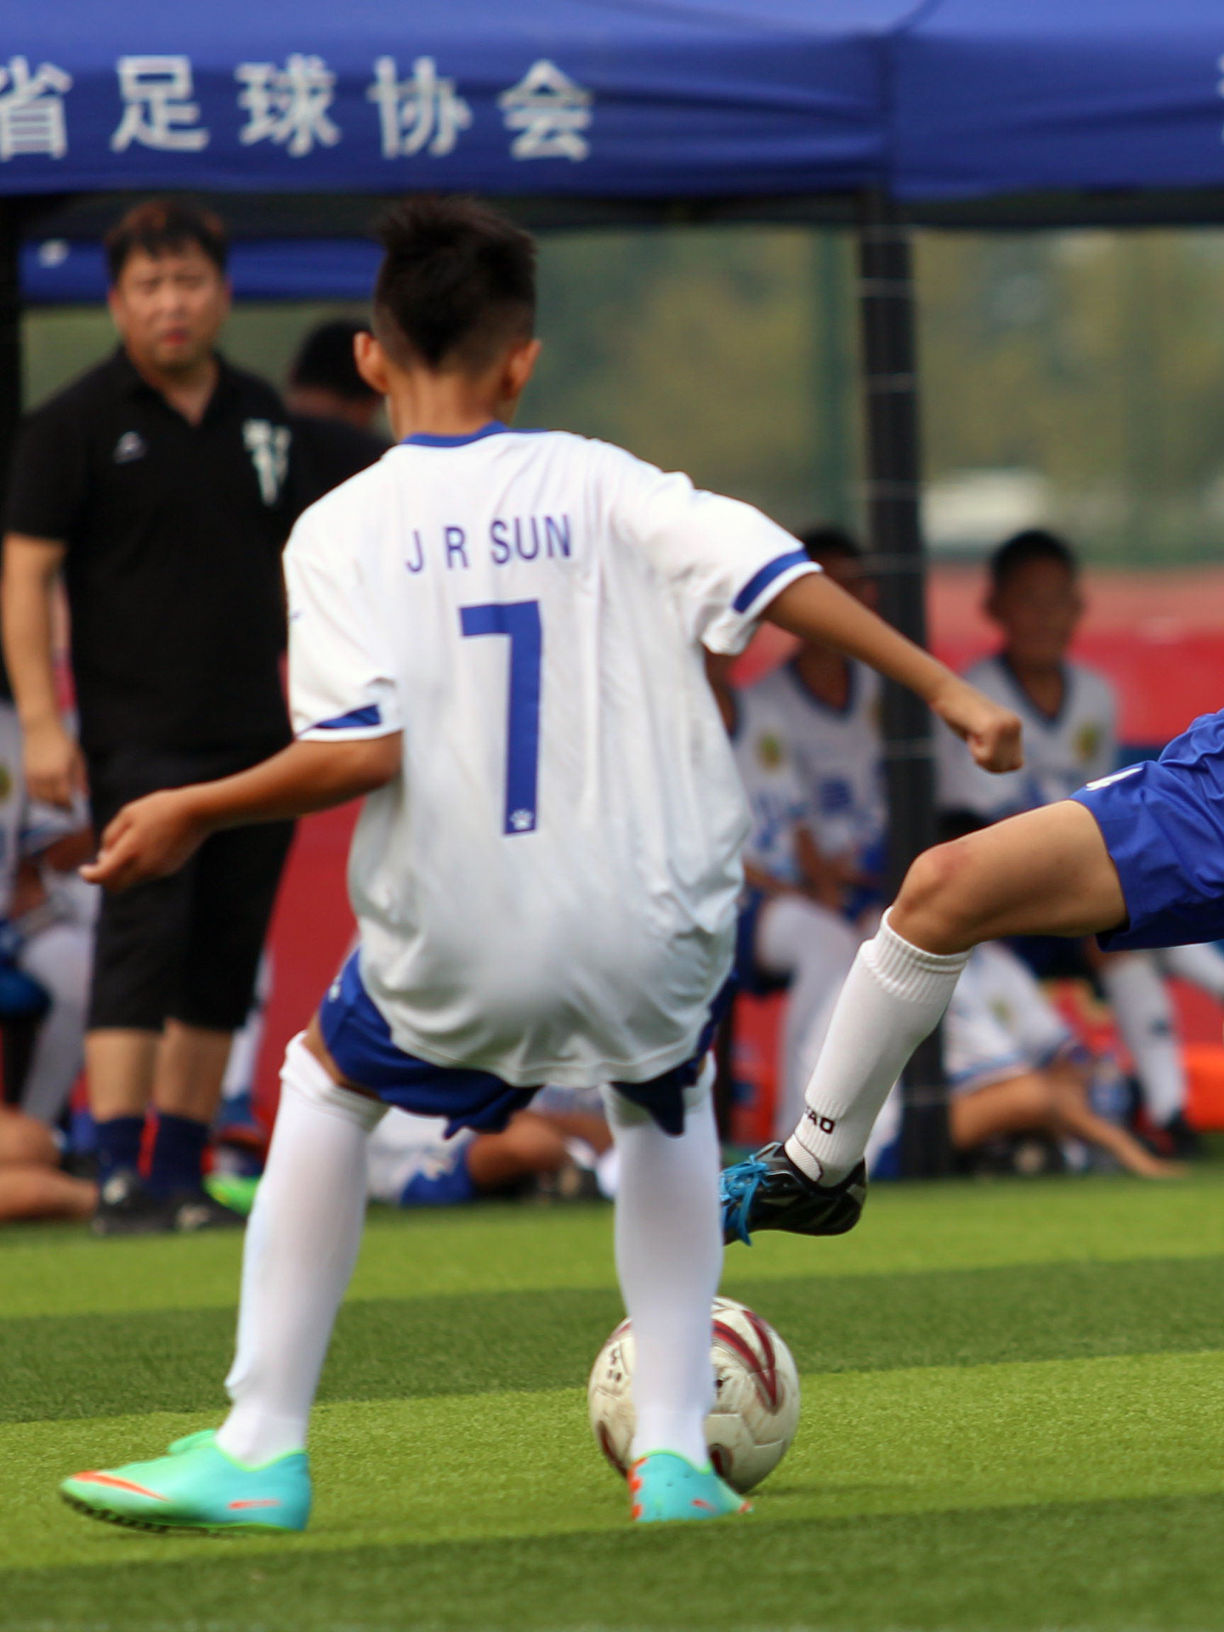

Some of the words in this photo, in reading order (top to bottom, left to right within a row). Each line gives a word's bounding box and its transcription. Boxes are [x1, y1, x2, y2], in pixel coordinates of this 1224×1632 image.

[0, 54, 594, 162] 省足球协会
[406, 529, 425, 574] J
[444, 526, 469, 570] R
[490, 515, 571, 565] SUN
[459, 599, 542, 836] 7
